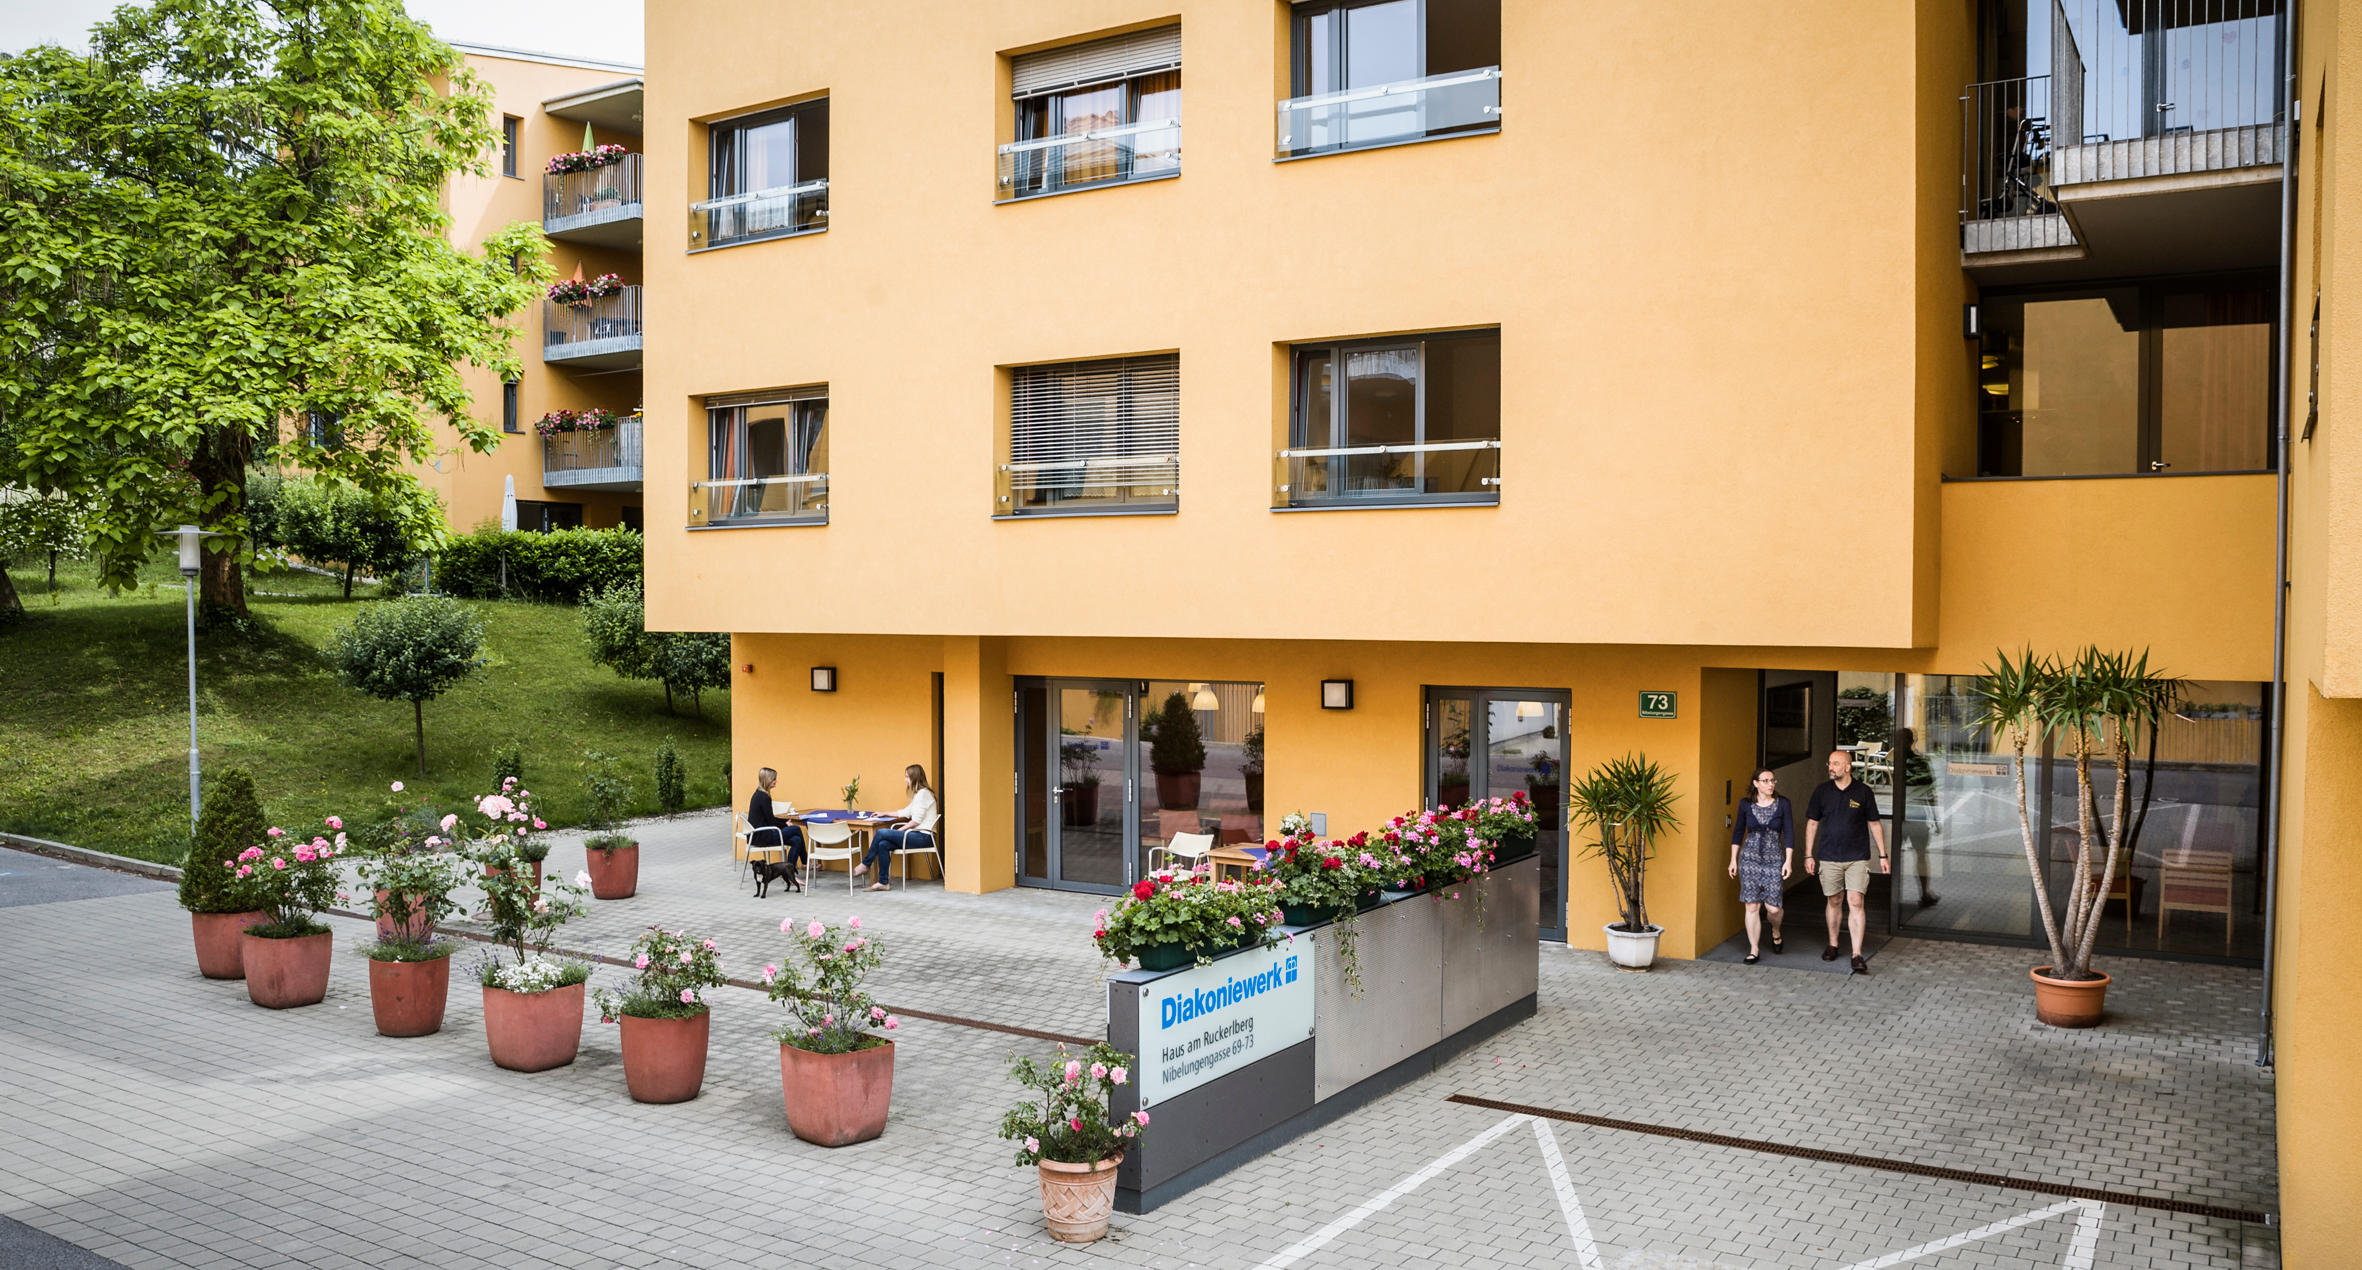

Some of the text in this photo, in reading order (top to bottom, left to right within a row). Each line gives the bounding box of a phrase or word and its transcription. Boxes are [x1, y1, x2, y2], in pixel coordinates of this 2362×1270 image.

[1647, 694, 1669, 710] 73
[1161, 962, 1283, 1030] Diakoniewerk
[1162, 1016, 1254, 1063] Haus am Ruckerlberg
[1162, 1033, 1254, 1085] Nibelungengasse 69-73
